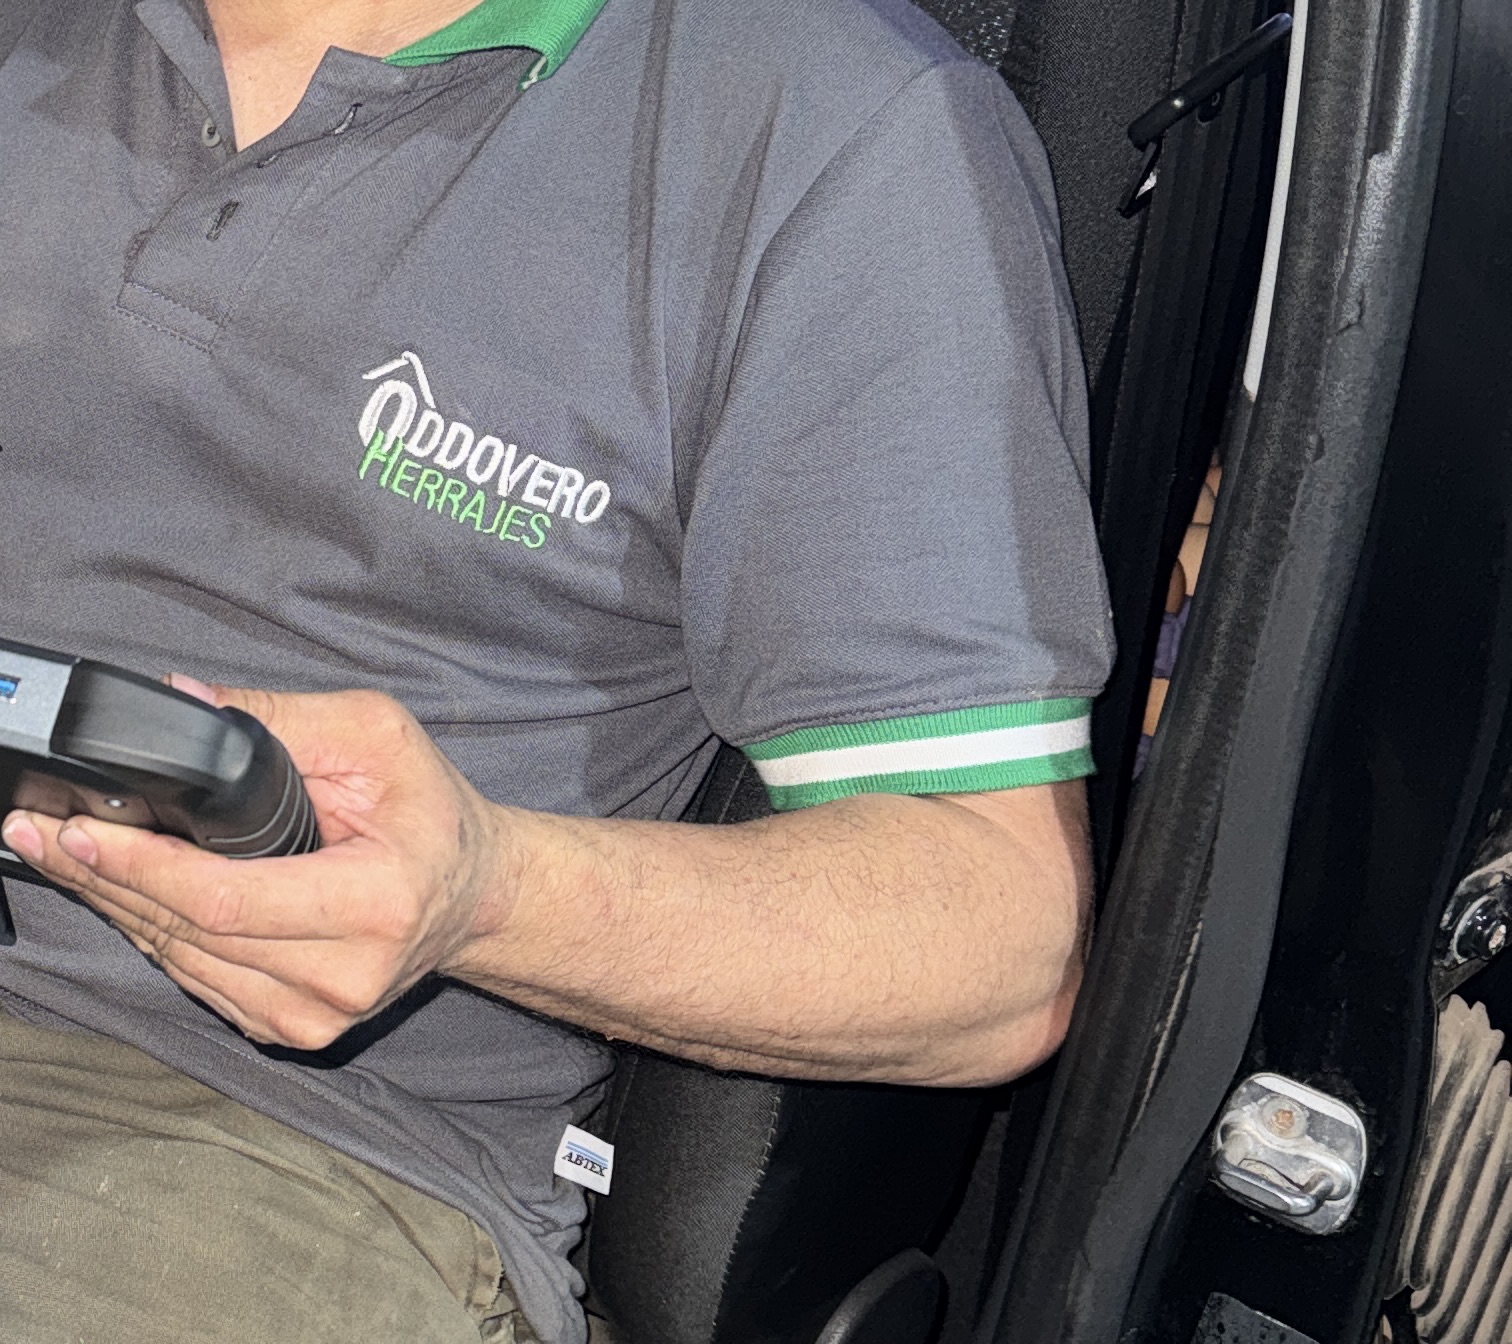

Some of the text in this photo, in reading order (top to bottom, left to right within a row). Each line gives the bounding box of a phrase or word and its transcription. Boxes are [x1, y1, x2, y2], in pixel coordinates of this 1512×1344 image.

[357, 428, 552, 549] HERRAJES
[358, 379, 611, 523] ODDOVERO
[561, 1151, 608, 1177] ABTEX
